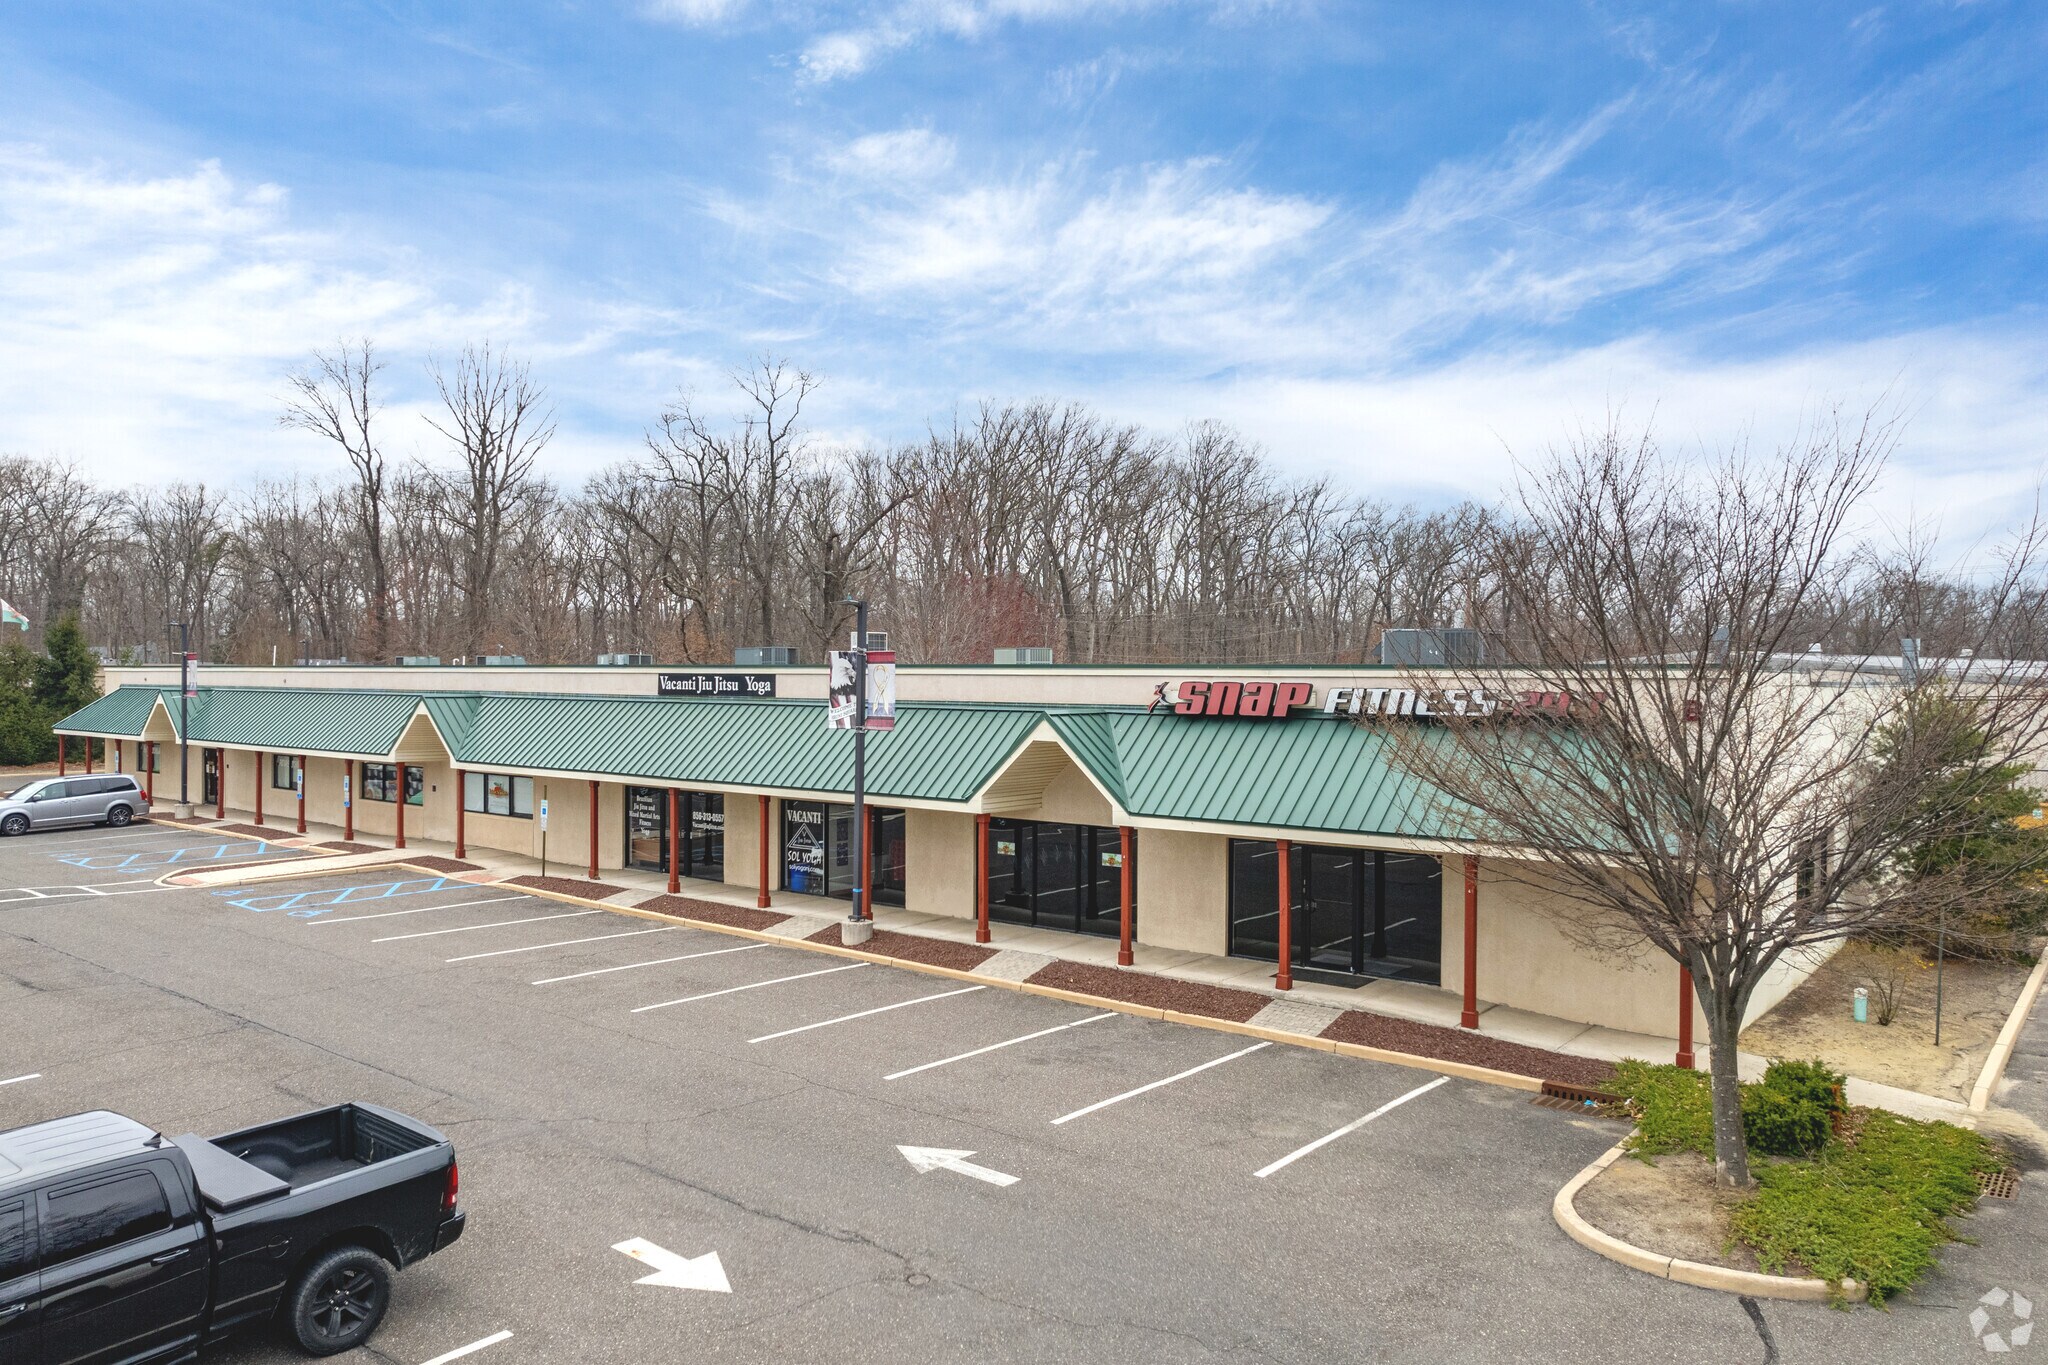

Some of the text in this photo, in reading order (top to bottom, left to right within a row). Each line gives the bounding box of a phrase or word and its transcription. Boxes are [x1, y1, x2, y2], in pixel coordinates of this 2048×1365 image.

[660, 676, 771, 695] Vacanti Jiu Jitsu Yoga
[787, 810, 821, 824] VACANTI
[787, 850, 822, 865] SOL YOGA
